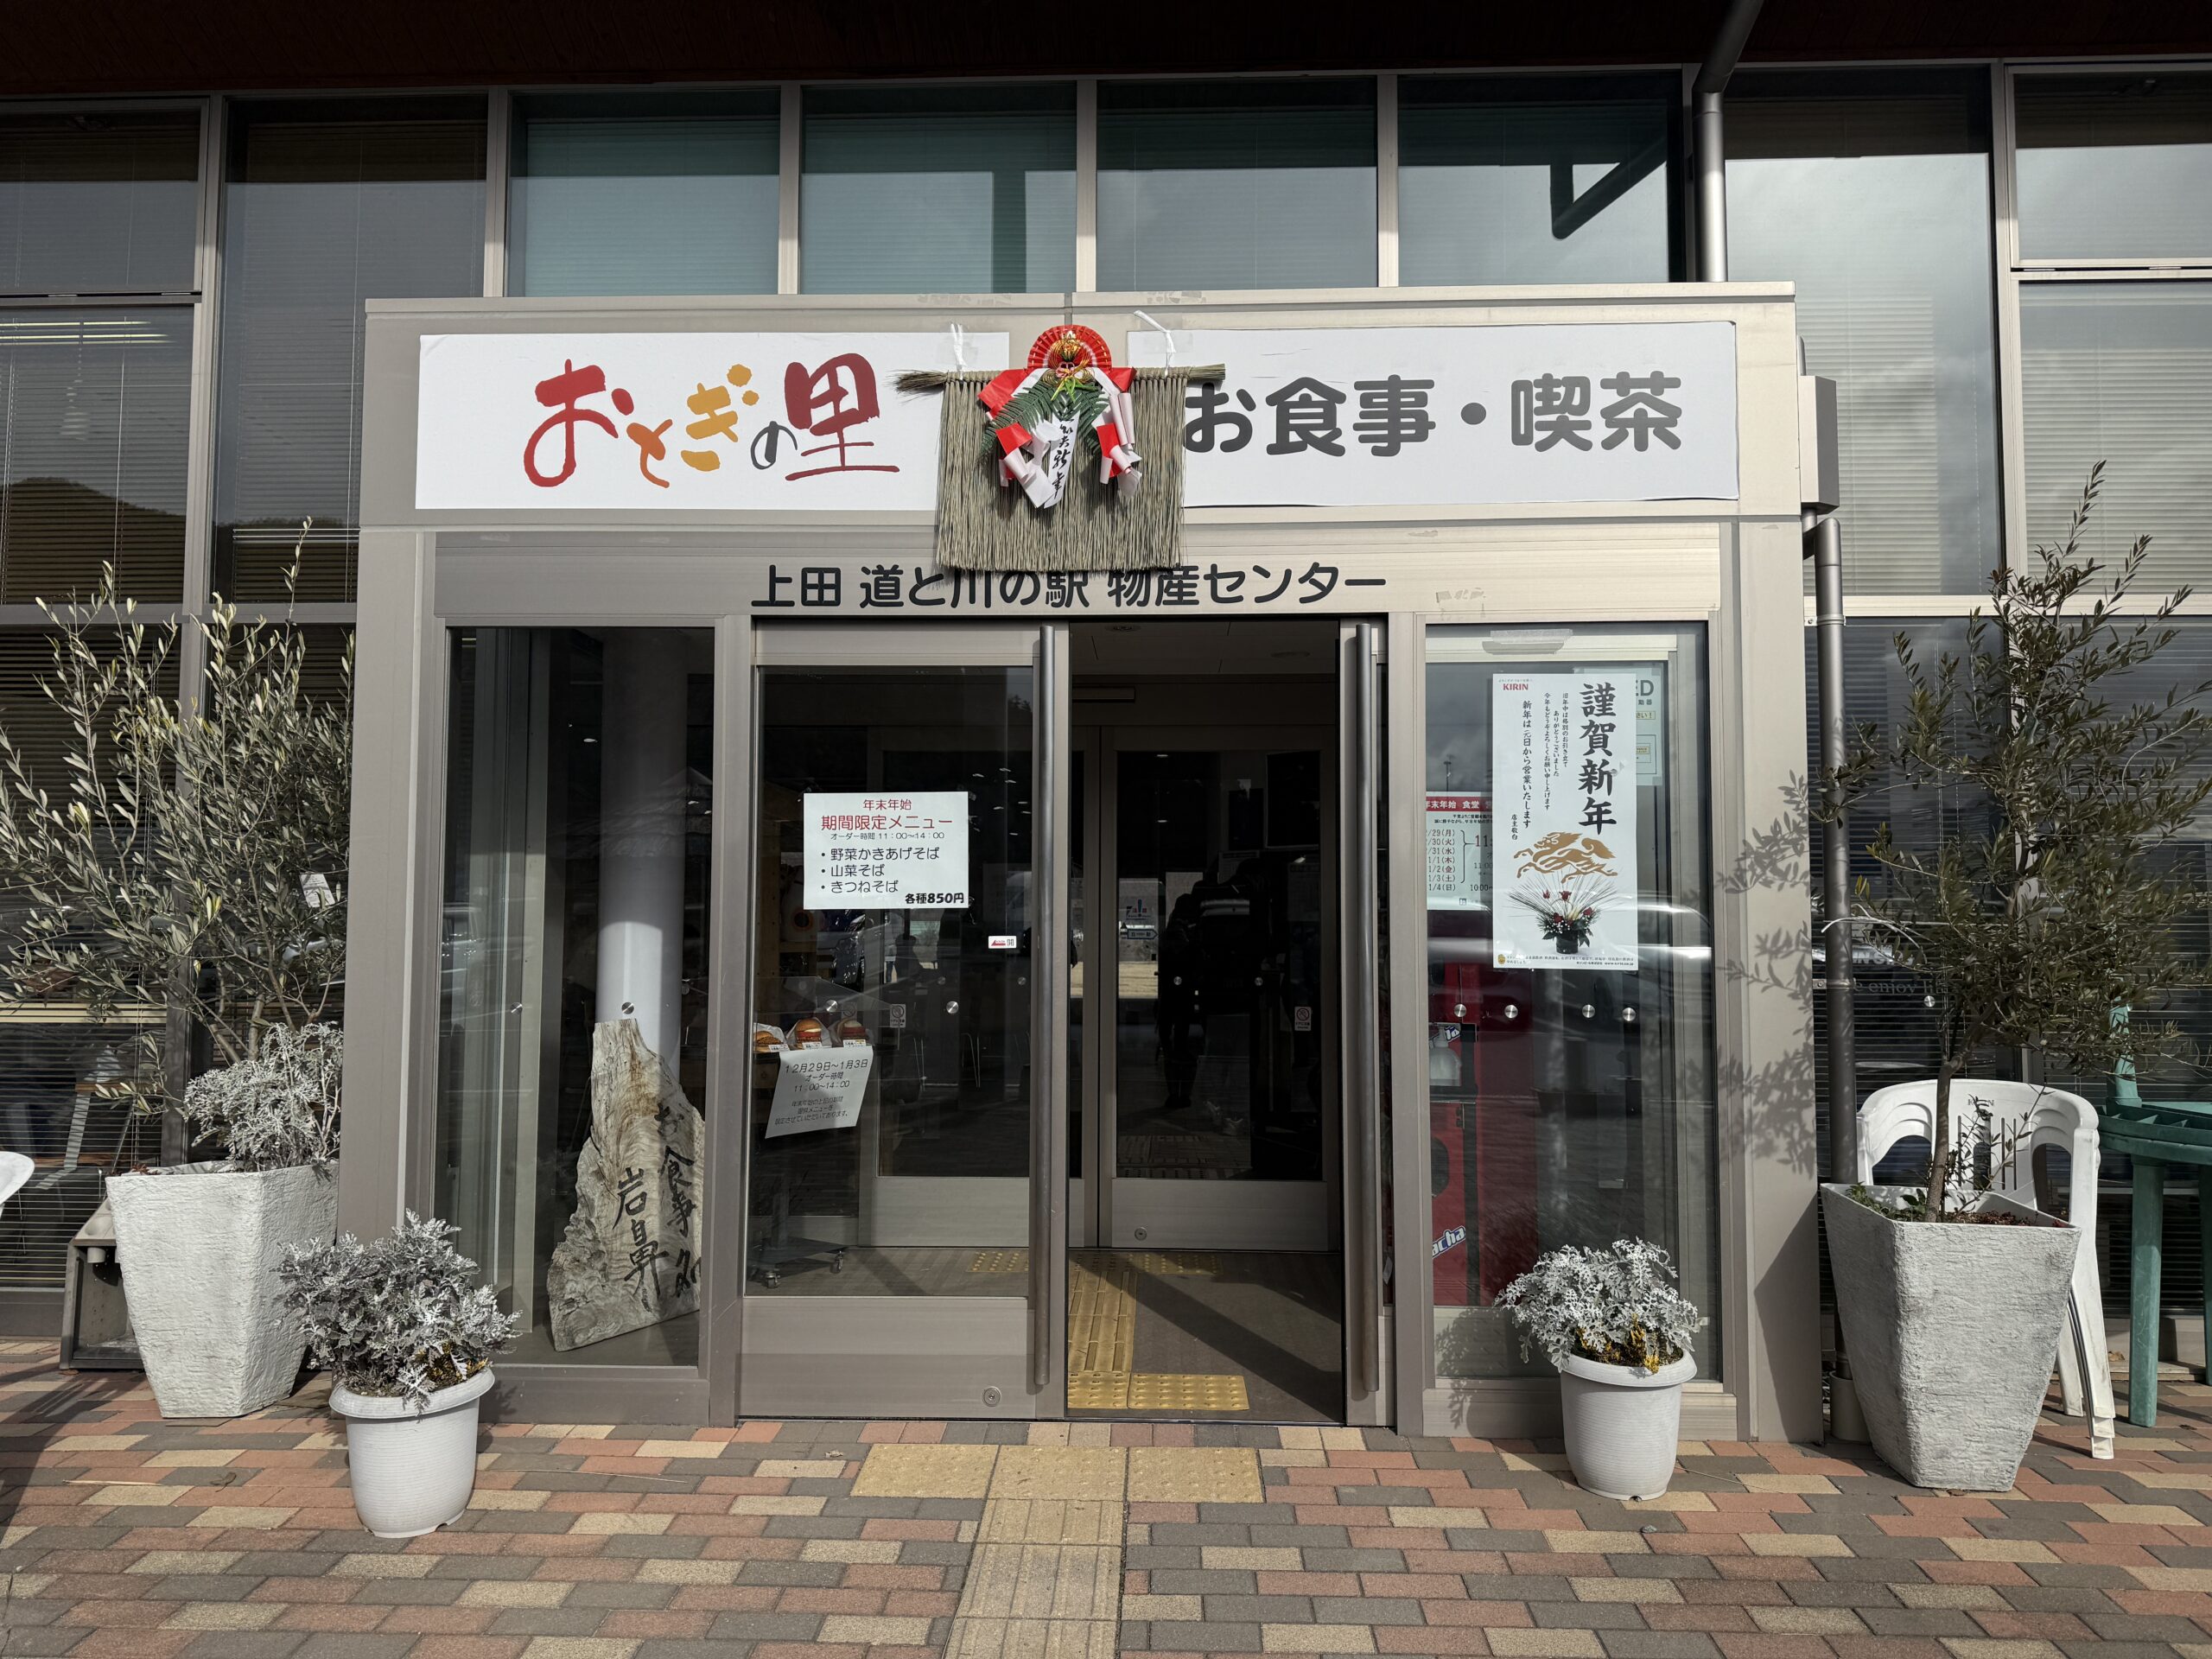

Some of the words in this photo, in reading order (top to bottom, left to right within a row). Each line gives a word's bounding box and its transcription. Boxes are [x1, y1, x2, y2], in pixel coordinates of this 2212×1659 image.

[524, 353, 899, 488] おとぎの里
[1185, 370, 1682, 458] お食事・喫茶
[751, 564, 841, 607] 上田
[860, 564, 1090, 608] 道と川の駅
[1108, 562, 1386, 607] 物産センター
[1578, 682, 1618, 835] 謹賀新年
[821, 815, 953, 830] 期間限定メニュー
[863, 799, 912, 810] 年末年始
[905, 893, 964, 904] 各種850円
[805, 1071, 843, 1082] オーダー時間
[613, 1166, 670, 1297] 岩鼻
